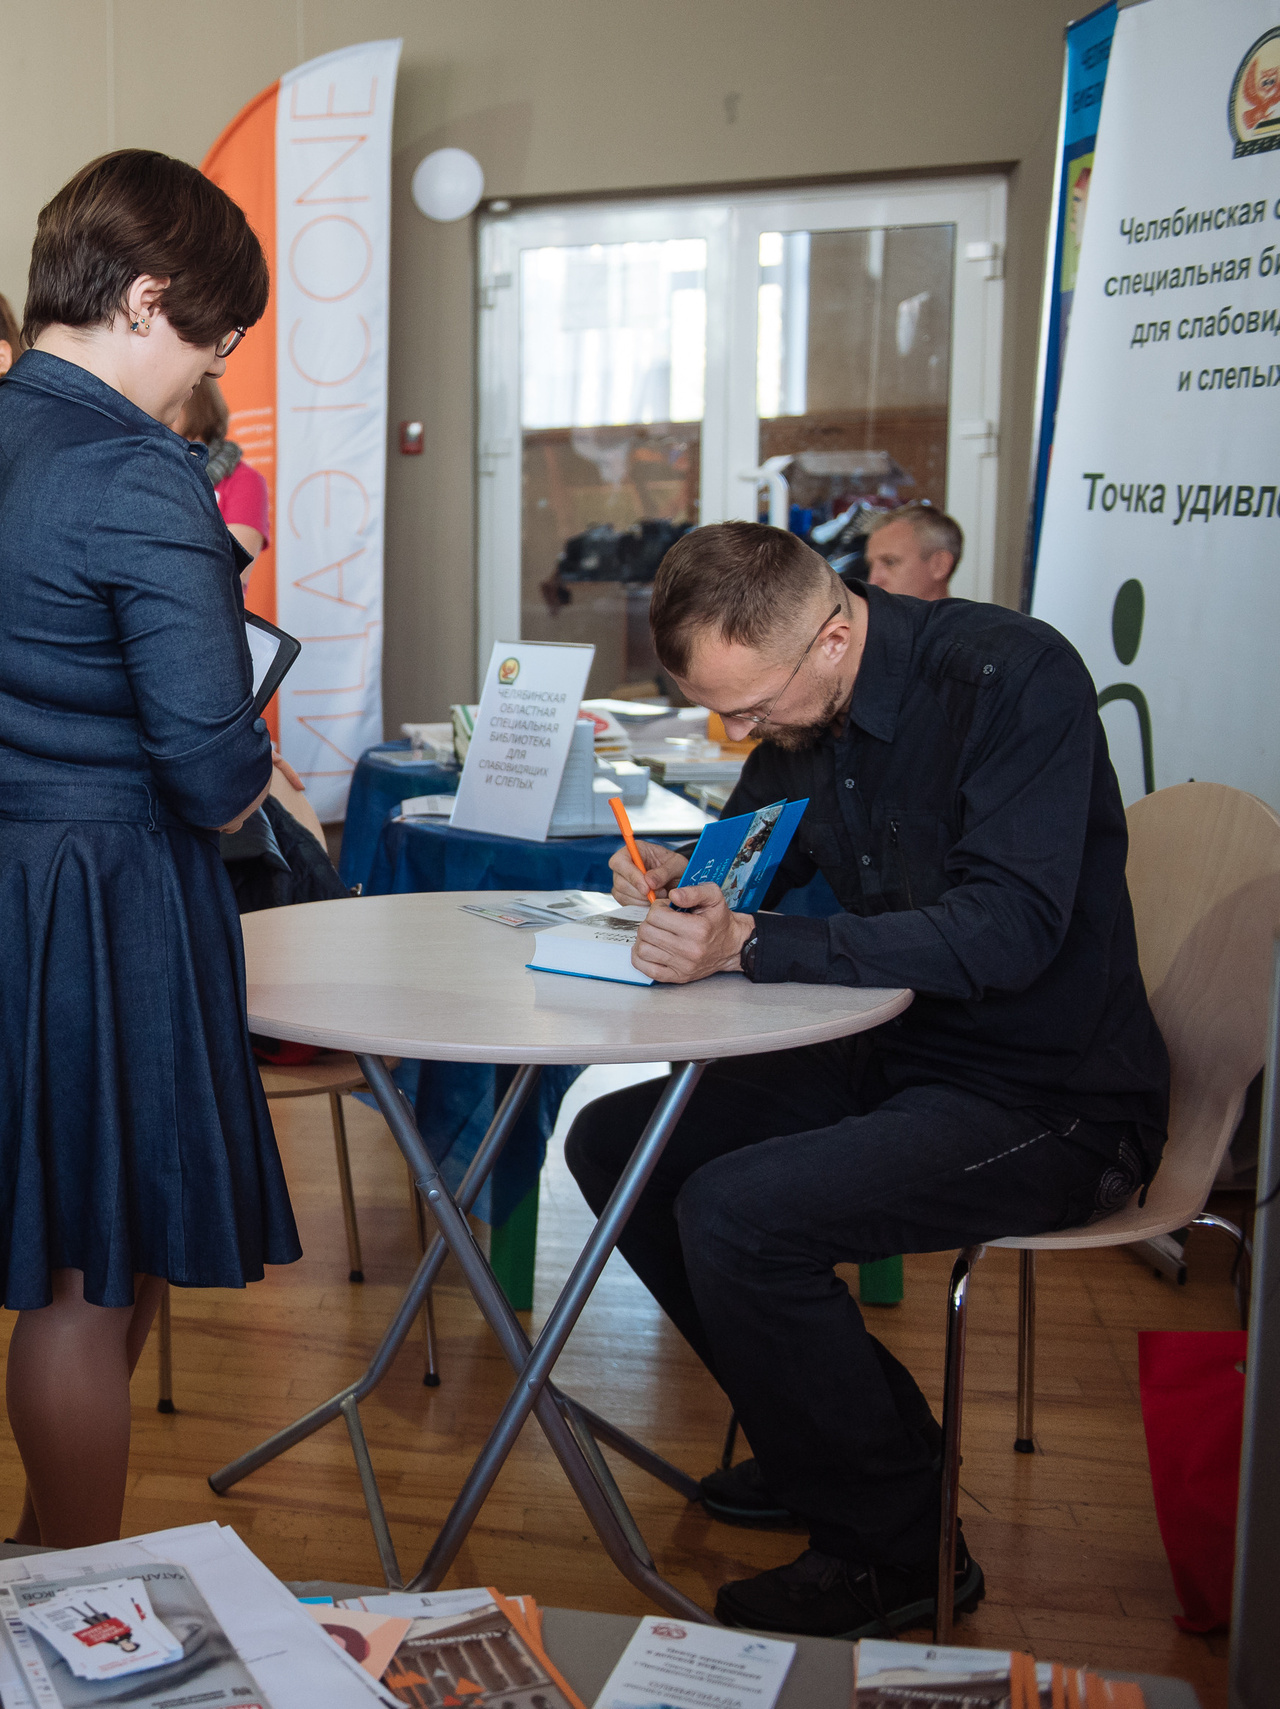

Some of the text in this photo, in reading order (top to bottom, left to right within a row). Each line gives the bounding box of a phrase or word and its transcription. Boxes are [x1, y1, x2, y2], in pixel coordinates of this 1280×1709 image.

[1119, 199, 1269, 245] Челябинская
[1104, 256, 1253, 297] специальная
[1130, 319, 1172, 349] для
[1177, 370, 1192, 392] и
[1083, 473, 1280, 526] Точка удивл
[498, 688, 567, 703] ЧЕЛЯБИНСКАЯ
[500, 703, 557, 718] ОБЛАСТНАЯ
[490, 716, 560, 732] СПЕЦИАЛЬНАЯ
[489, 731, 551, 748] БИБЛИОТЕКА
[505, 748, 527, 760] ДЛЯ
[478, 759, 549, 777] СЛАБОВИДЯЩИХ
[485, 775, 535, 790] И СЛЕПЫХ
